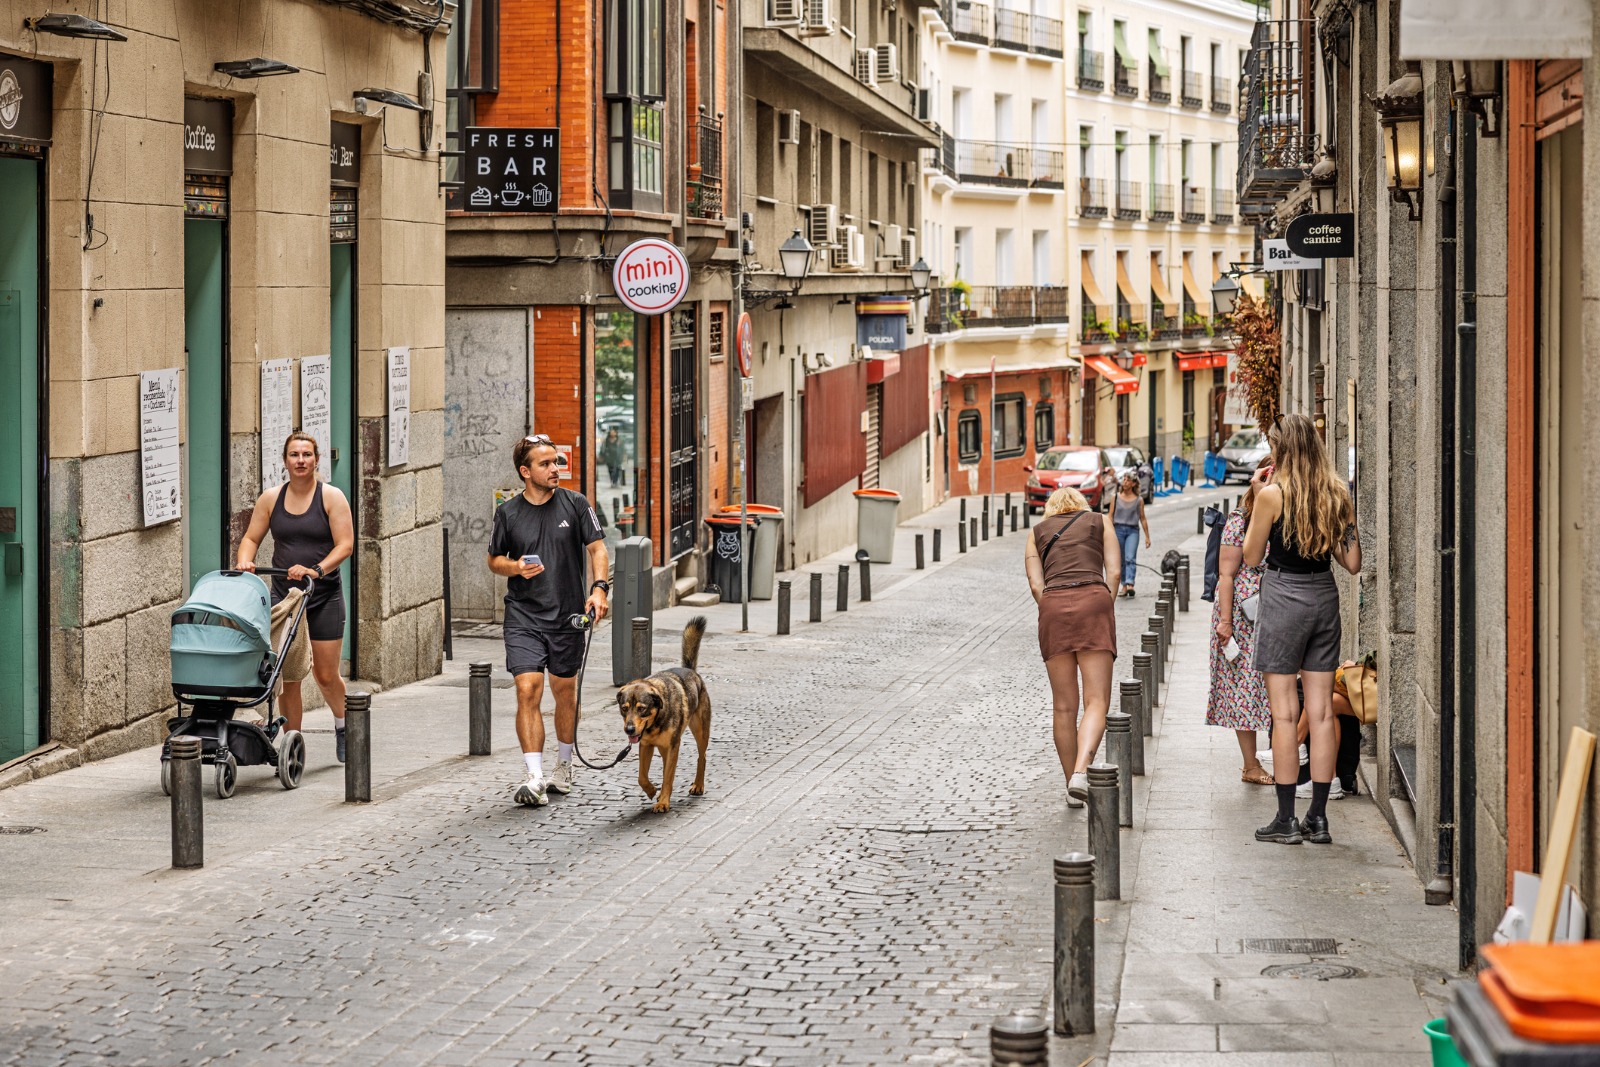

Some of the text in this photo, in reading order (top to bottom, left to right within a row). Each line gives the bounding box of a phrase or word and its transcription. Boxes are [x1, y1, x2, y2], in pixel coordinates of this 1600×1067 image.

[184, 124, 216, 151] Coffee
[470, 133, 553, 148] FRESH
[339, 146, 354, 167] Bar
[477, 156, 546, 176] BAR
[1308, 224, 1342, 235] coffee
[1302, 235, 1342, 244] cantine
[626, 255, 673, 283] mini
[627, 281, 677, 298] cooking
